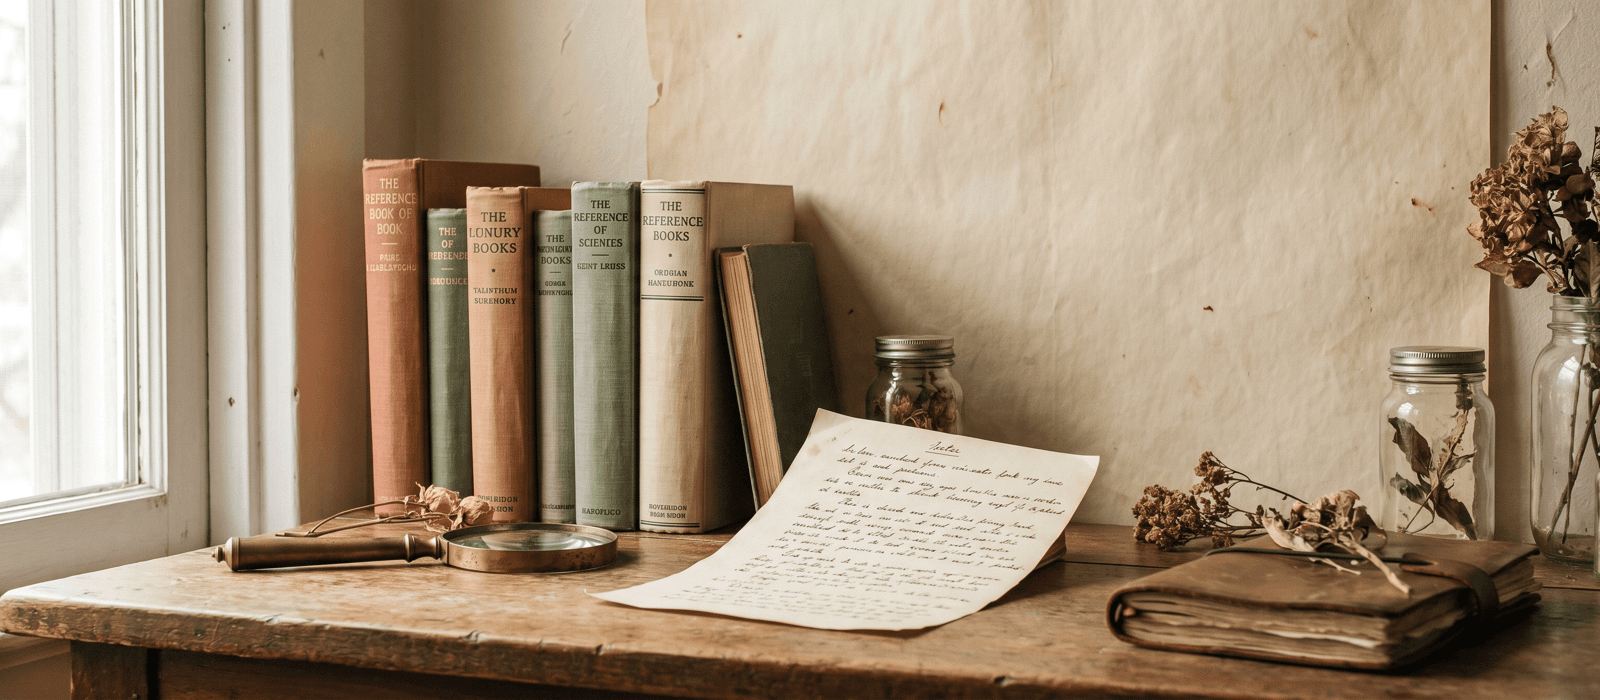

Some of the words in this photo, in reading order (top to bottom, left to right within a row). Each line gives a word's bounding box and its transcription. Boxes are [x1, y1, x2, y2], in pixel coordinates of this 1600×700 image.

[379, 178, 400, 189] THE
[365, 193, 417, 204] REFERENCE
[591, 200, 611, 209] THE
[660, 201, 682, 212] THE
[369, 208, 394, 220] BOOK
[398, 208, 413, 219] OF
[481, 211, 507, 223] THE
[574, 212, 629, 222] REFERENCE
[642, 215, 704, 227] REFERENCE
[377, 223, 403, 235] BOOK
[438, 227, 457, 236] THE
[469, 227, 522, 238] LONURY
[593, 225, 608, 235] OF
[546, 234, 565, 243] THE
[653, 230, 690, 242] BOOKS
[441, 240, 454, 249] OF
[473, 242, 517, 254] BOOKS
[541, 256, 572, 265] BOOKS
